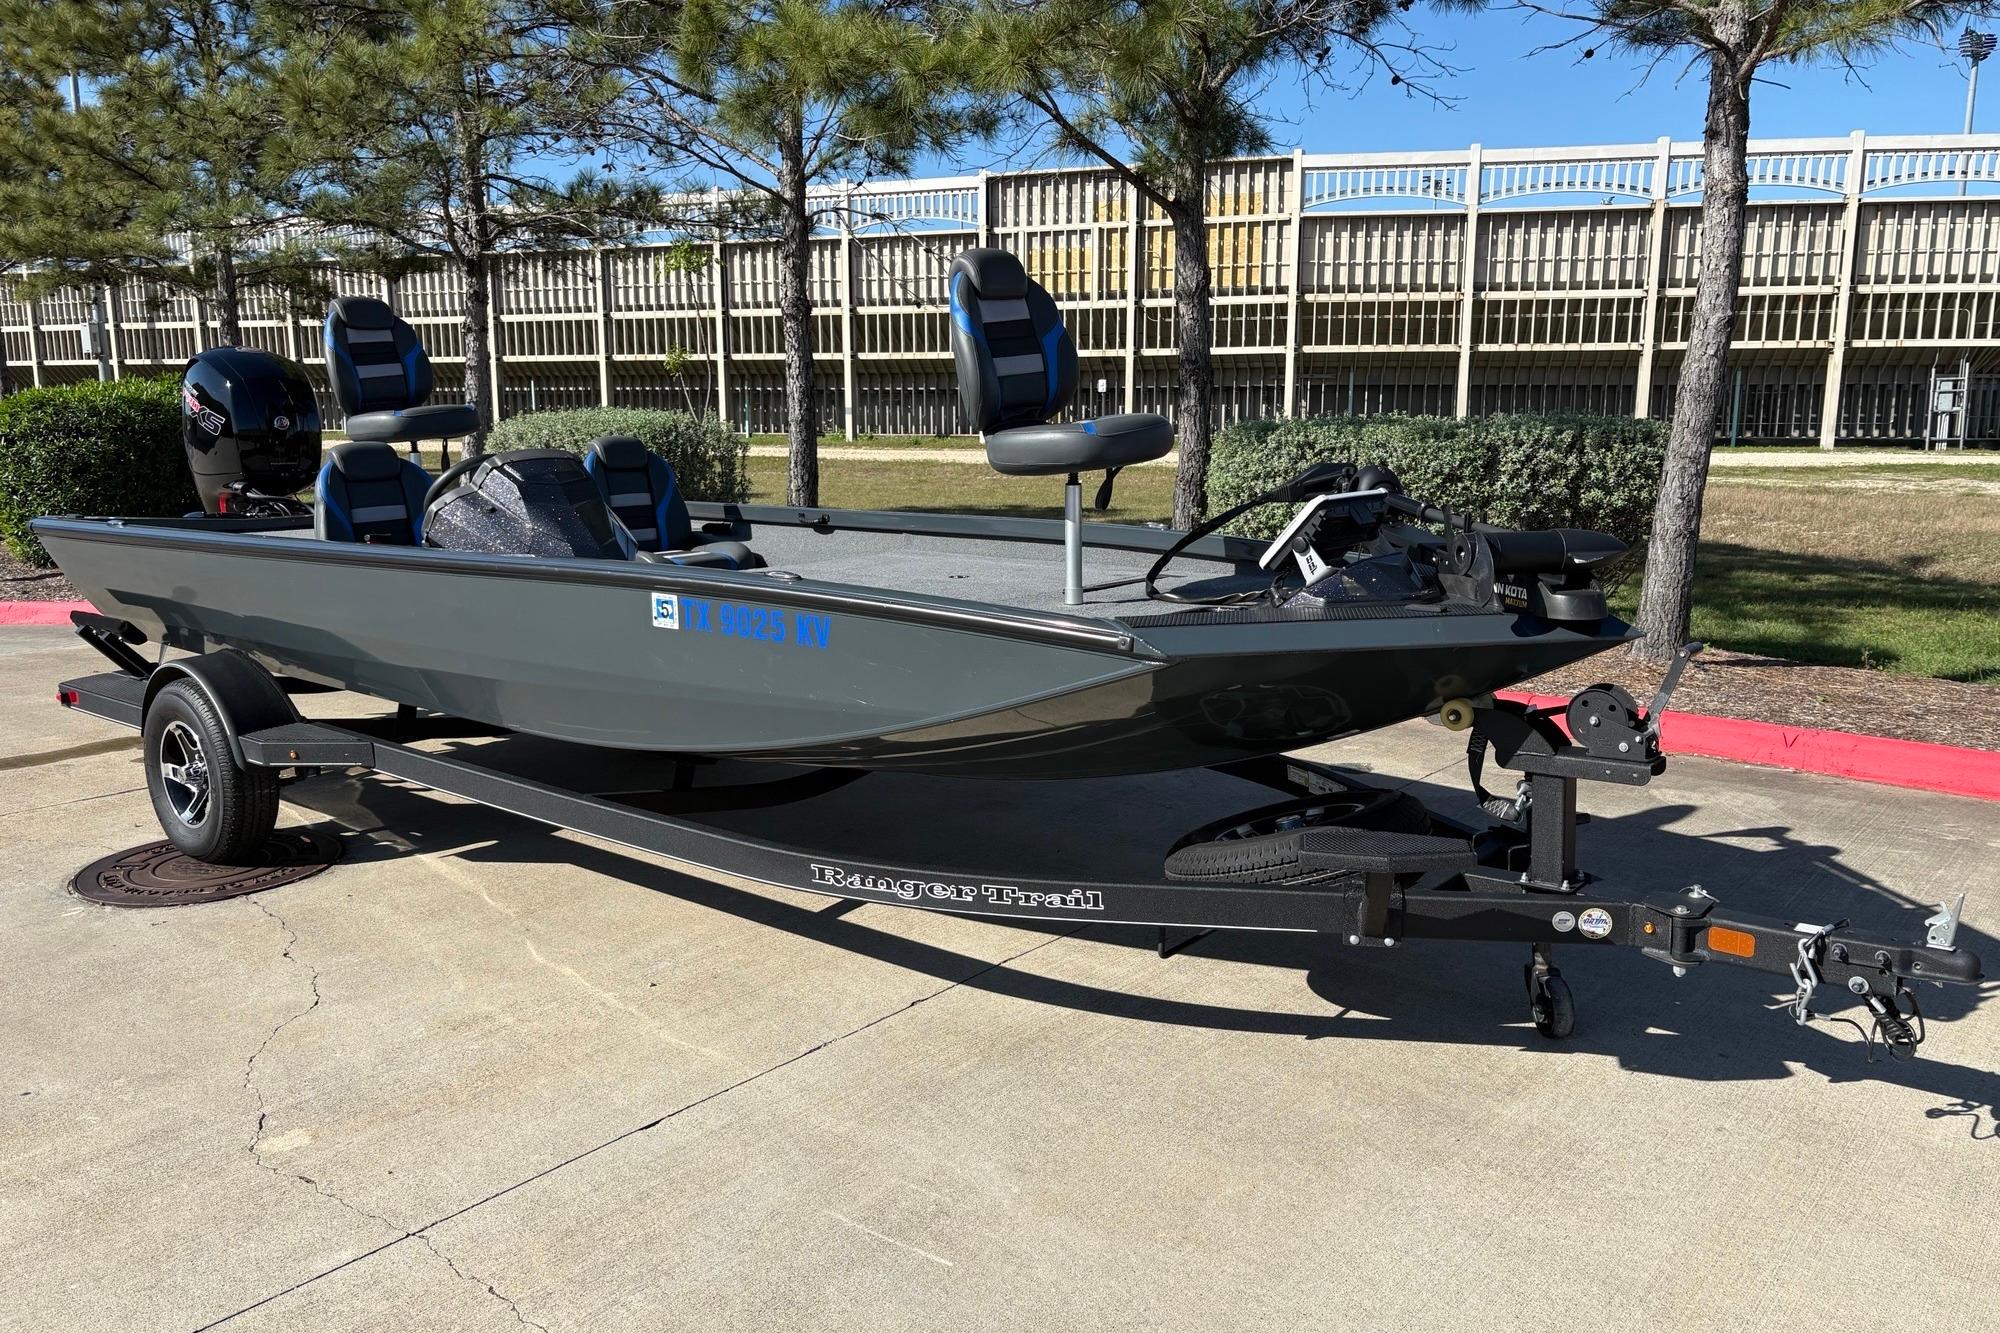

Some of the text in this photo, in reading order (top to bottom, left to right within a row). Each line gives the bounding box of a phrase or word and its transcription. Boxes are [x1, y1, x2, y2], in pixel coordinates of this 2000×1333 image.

[1505, 584, 1528, 600] KOTA
[661, 600, 670, 619] 5
[679, 597, 832, 650] TX 9025 KV
[810, 863, 1105, 910] Ranger Trail
